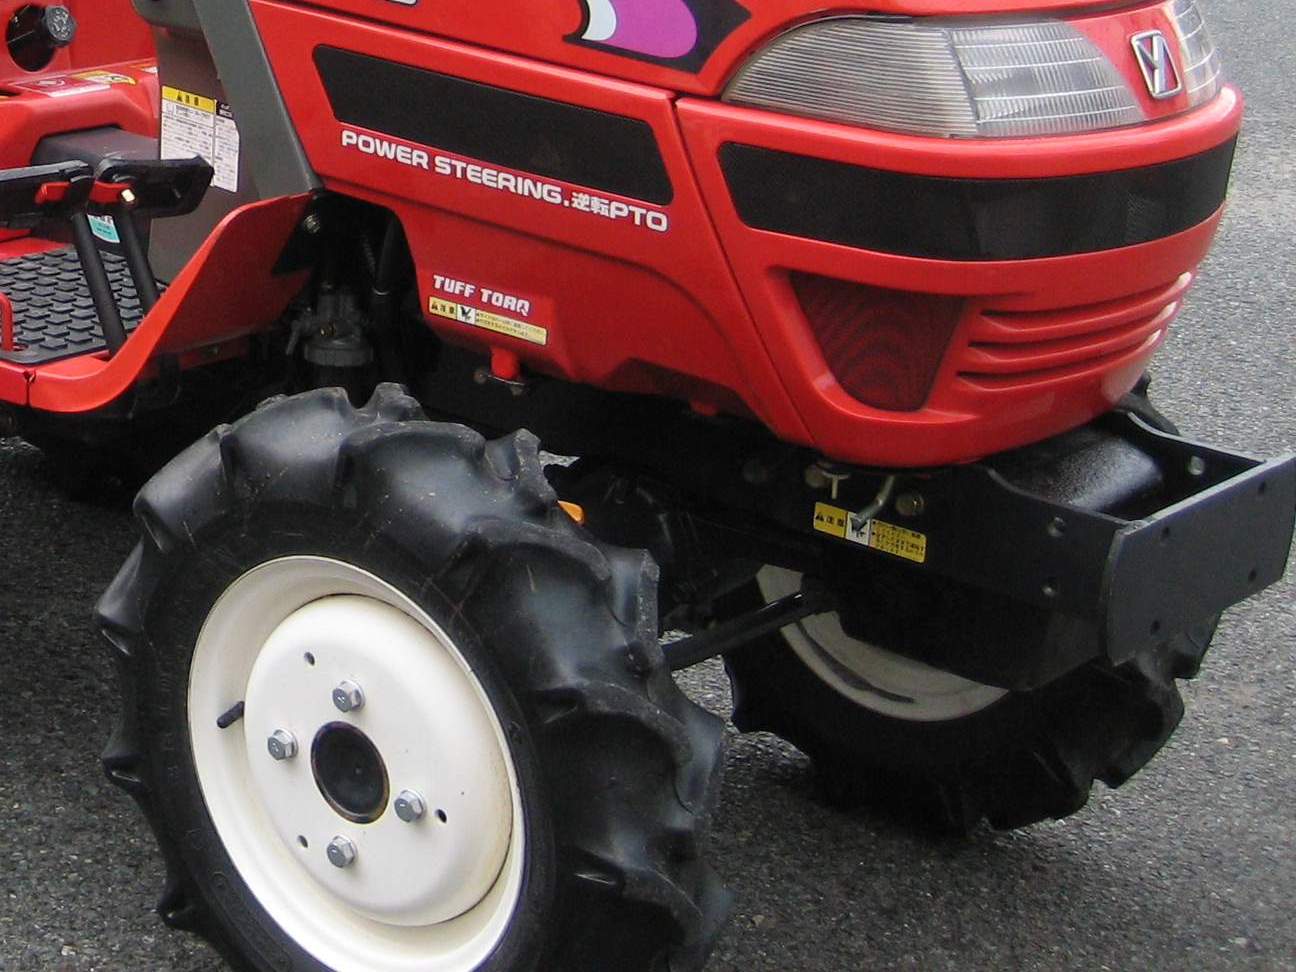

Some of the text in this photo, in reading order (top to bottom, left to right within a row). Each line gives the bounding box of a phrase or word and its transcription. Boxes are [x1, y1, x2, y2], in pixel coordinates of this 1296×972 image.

[341, 130, 429, 170] POWER
[433, 274, 531, 316] TUFF TORQ
